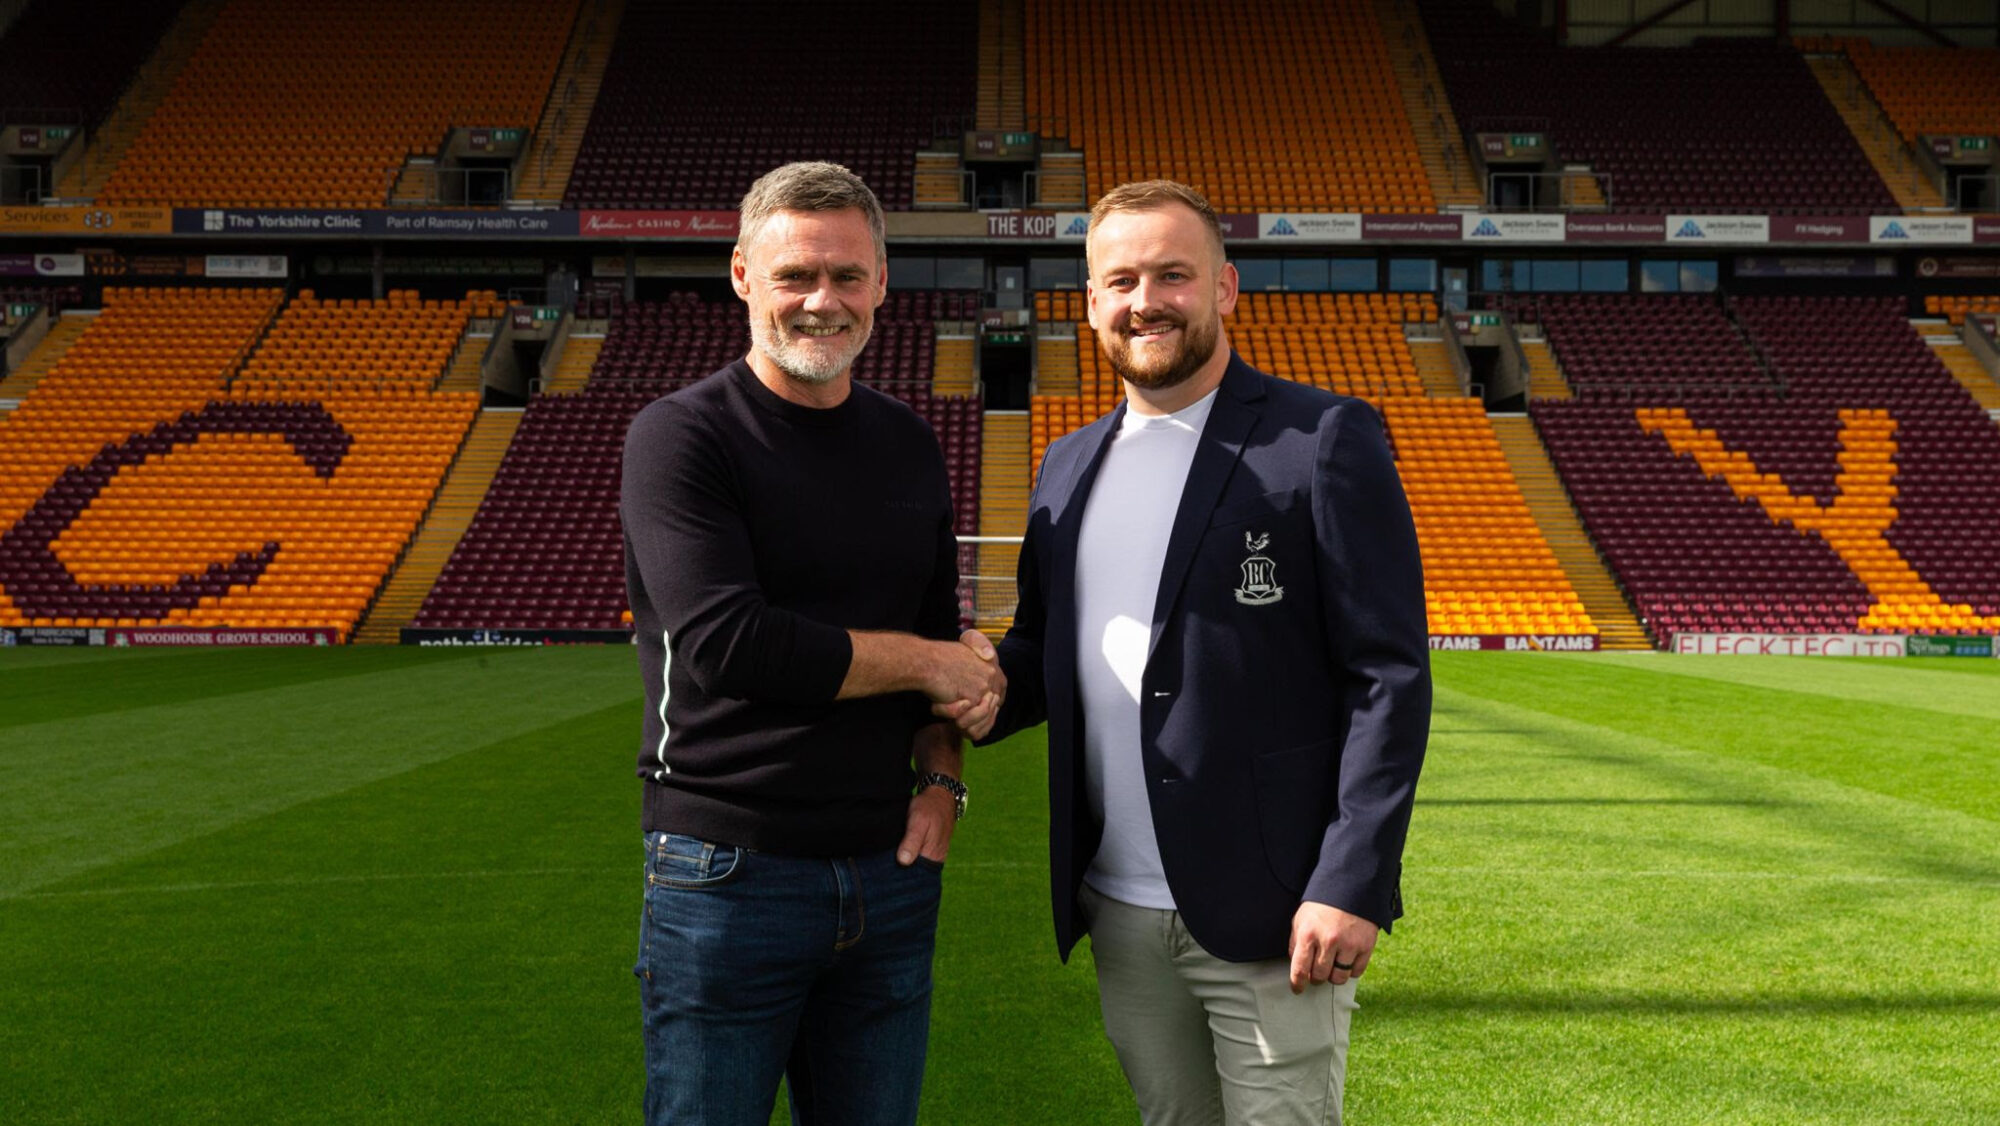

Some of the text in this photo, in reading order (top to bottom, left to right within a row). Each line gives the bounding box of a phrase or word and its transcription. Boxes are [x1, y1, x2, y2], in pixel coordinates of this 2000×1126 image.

[4, 210, 70, 223] Services
[228, 215, 362, 228] The Yorkshire Clinic
[1298, 219, 1355, 227] Jackson Swiss
[386, 216, 548, 231] Part of Ramsay Health Care
[637, 219, 681, 228] CASINO
[989, 216, 1055, 235] THE KOP
[1365, 222, 1458, 232] International Payments
[1501, 219, 1559, 228] Jackson Swiss
[1568, 223, 1664, 232] Overseas Bank Accounts
[0, 400, 354, 620] C
[1635, 408, 2000, 628] Y
[133, 632, 310, 644] WOODHOUSE GROVE SCHOOL
[1429, 636, 1481, 650] TAMS
